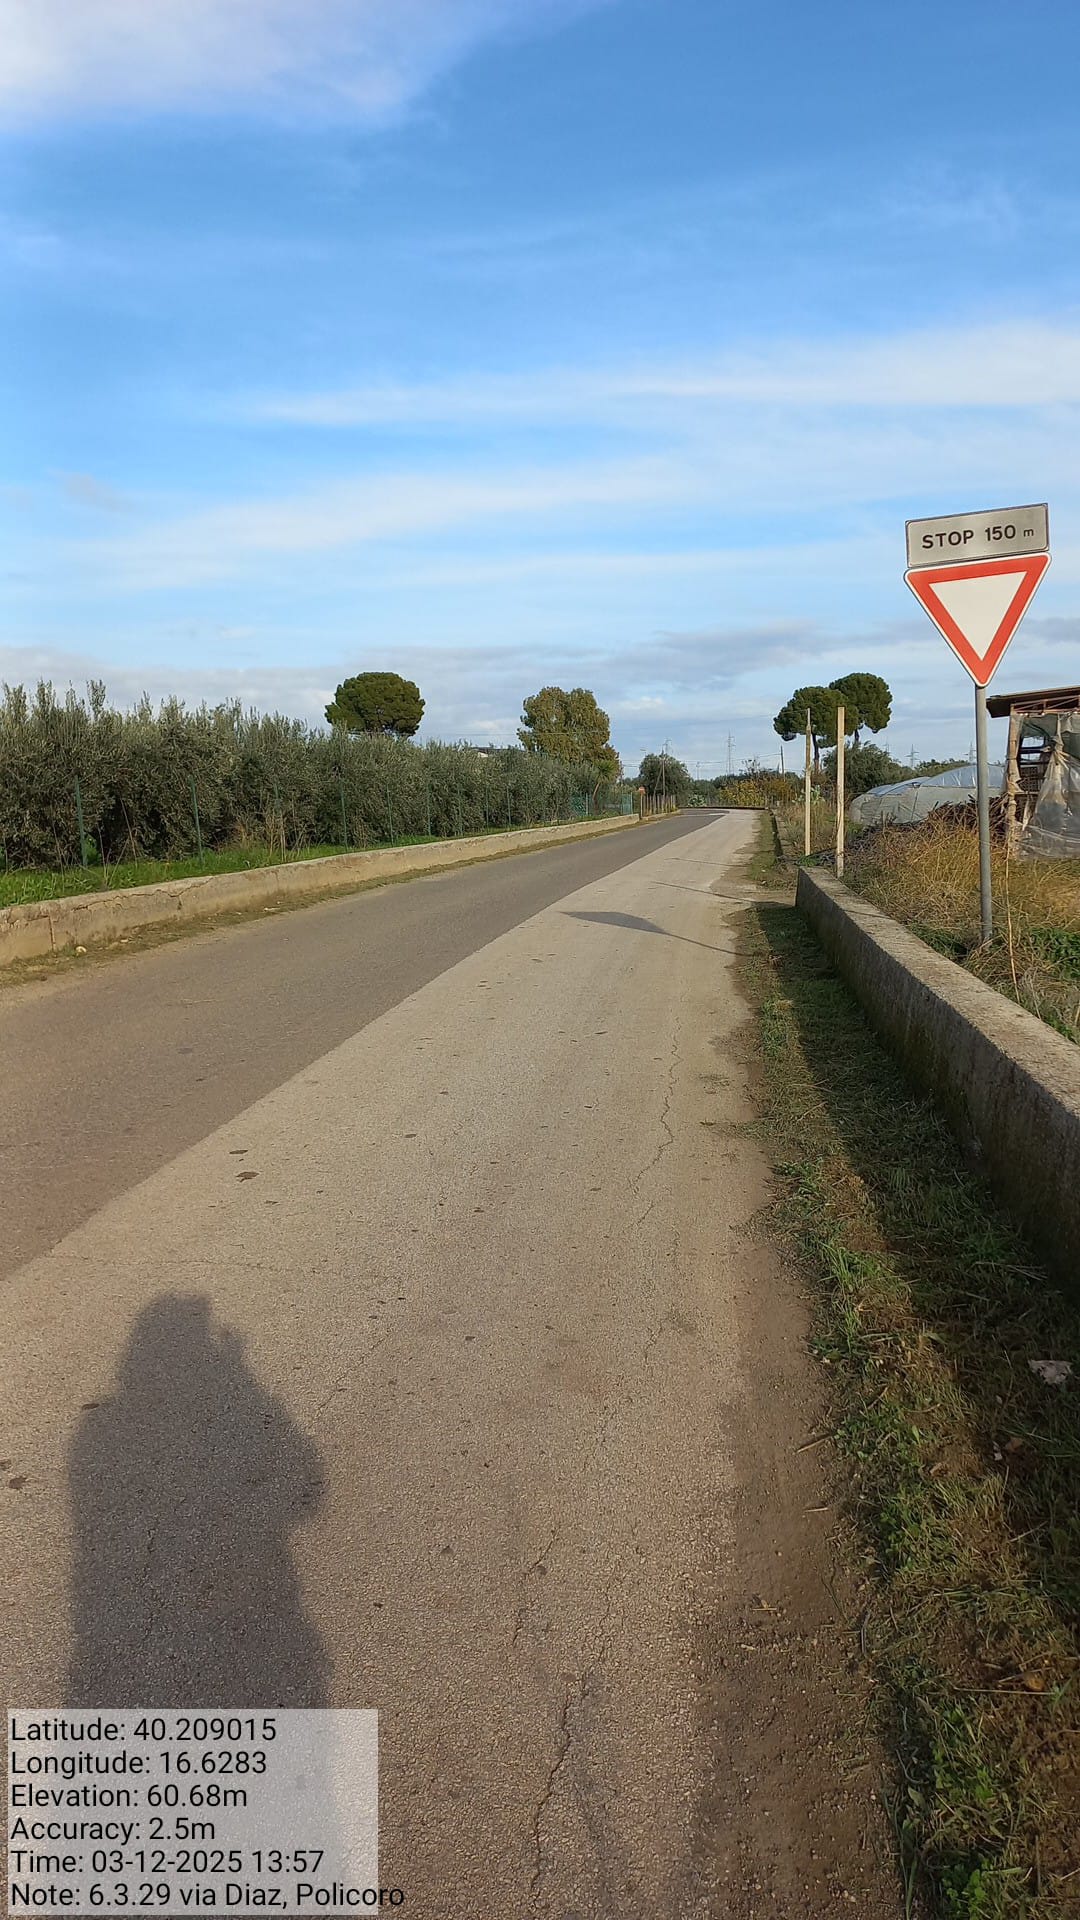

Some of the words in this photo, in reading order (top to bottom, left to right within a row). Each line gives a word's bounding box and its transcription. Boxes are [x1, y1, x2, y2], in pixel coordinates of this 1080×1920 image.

[922, 529, 974, 549] STOP
[984, 525, 1016, 541] 150
[1023, 528, 1034, 538] m
